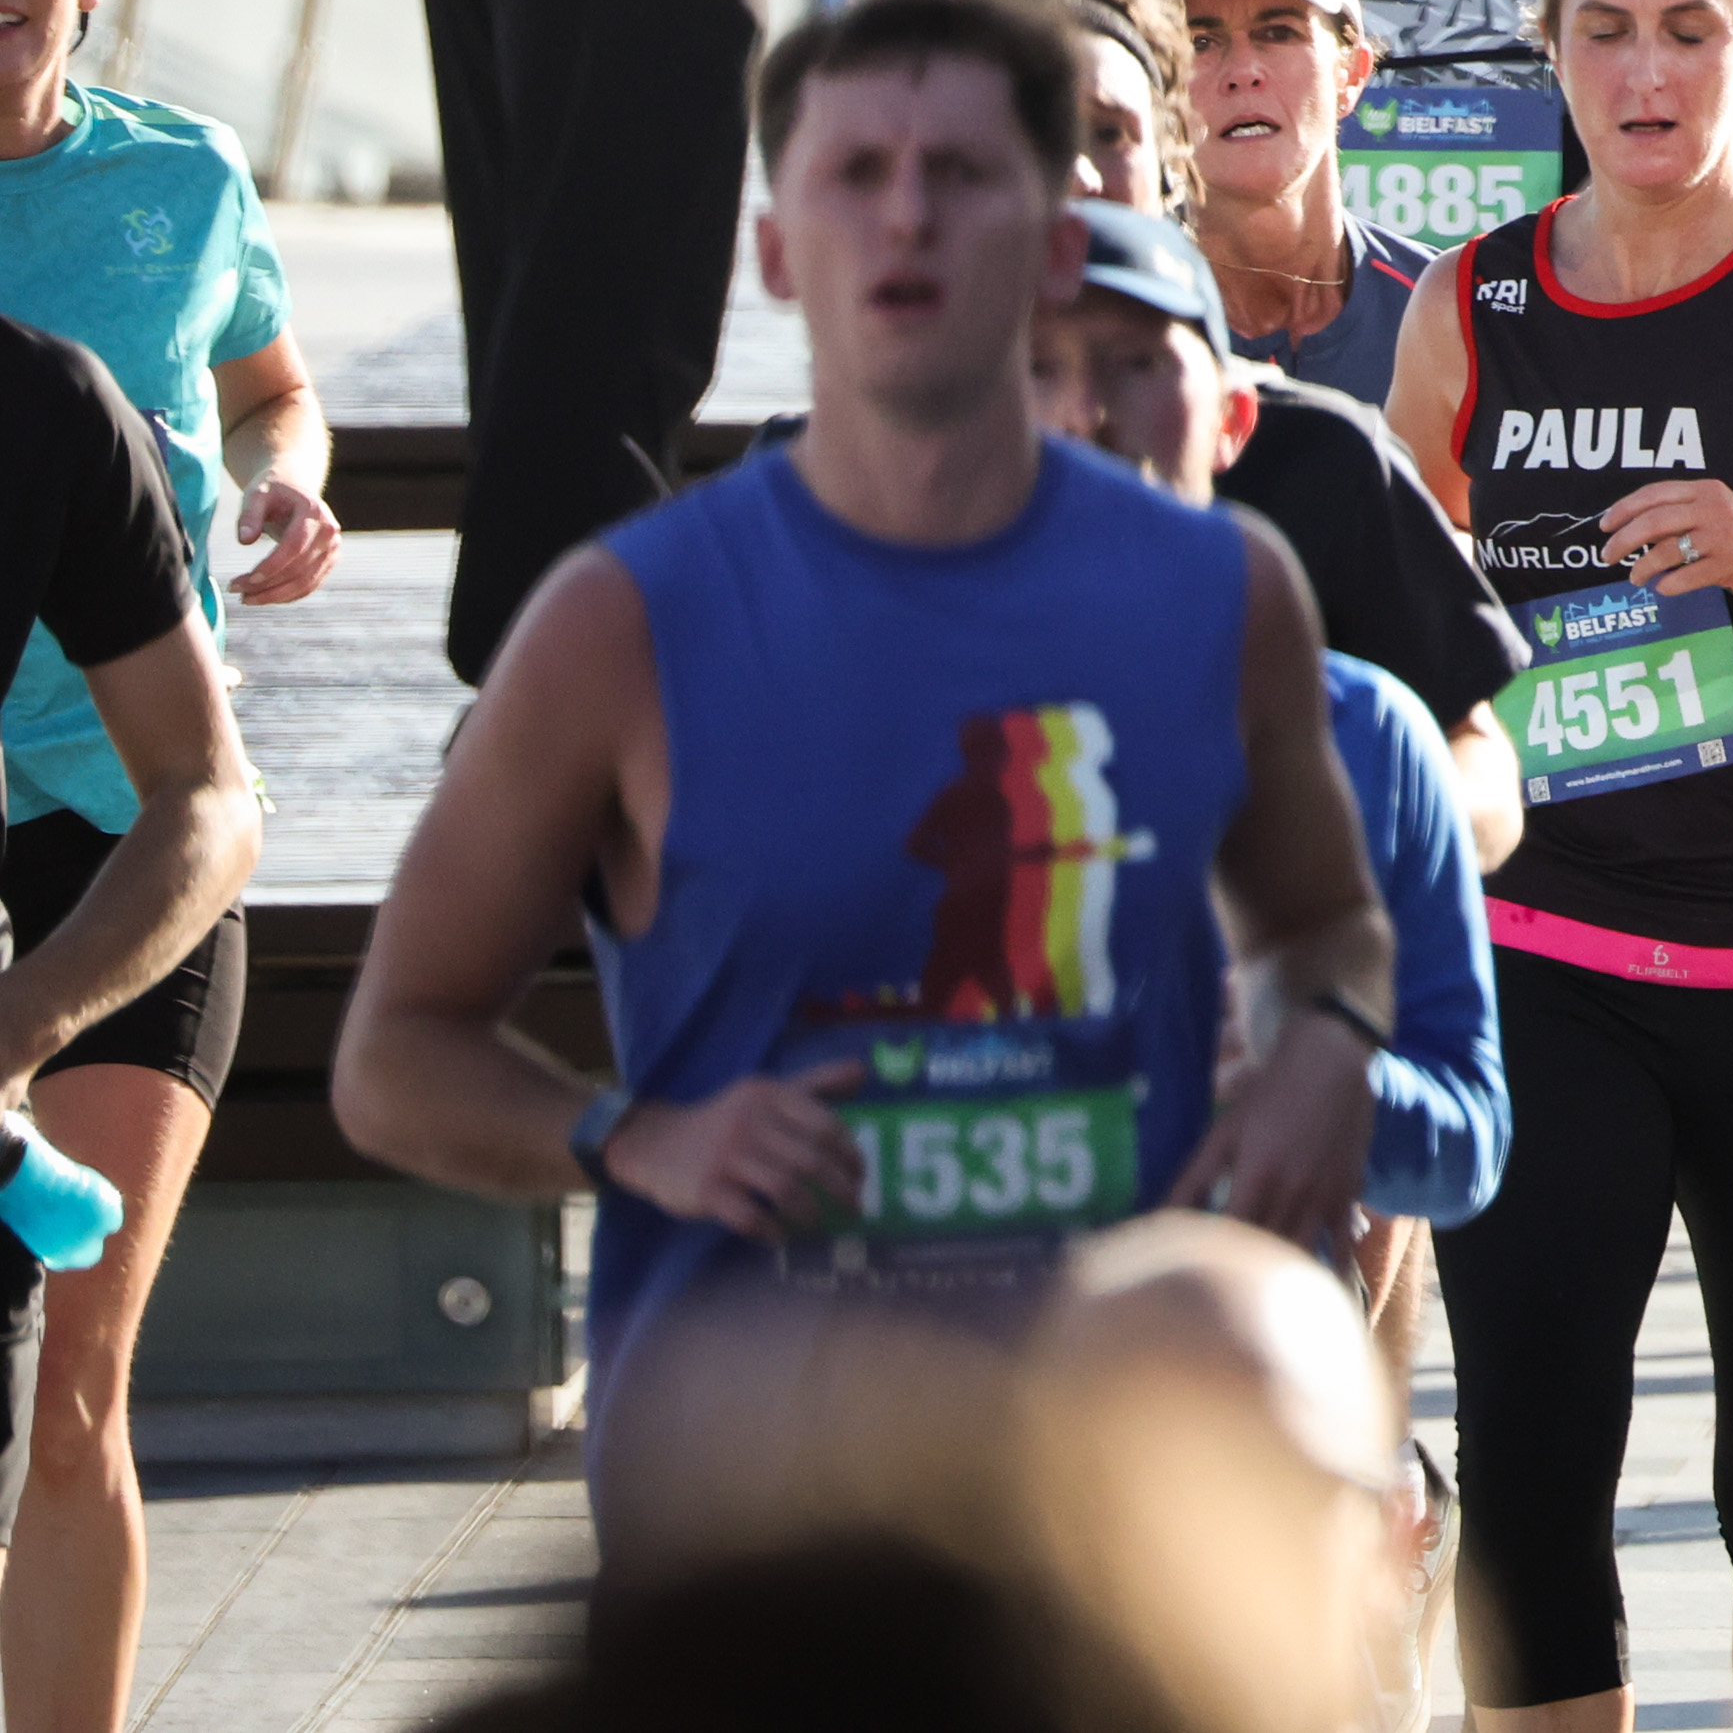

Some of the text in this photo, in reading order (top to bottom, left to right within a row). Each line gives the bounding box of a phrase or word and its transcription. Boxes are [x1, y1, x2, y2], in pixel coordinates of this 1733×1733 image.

[1397, 115, 1497, 134] BELFAST
[1342, 163, 1526, 236] 4885
[1492, 406, 1706, 469] PAULA
[1565, 604, 1659, 641] BELFAST
[1527, 650, 1705, 756] 4551
[855, 1107, 1094, 1221] 1535
